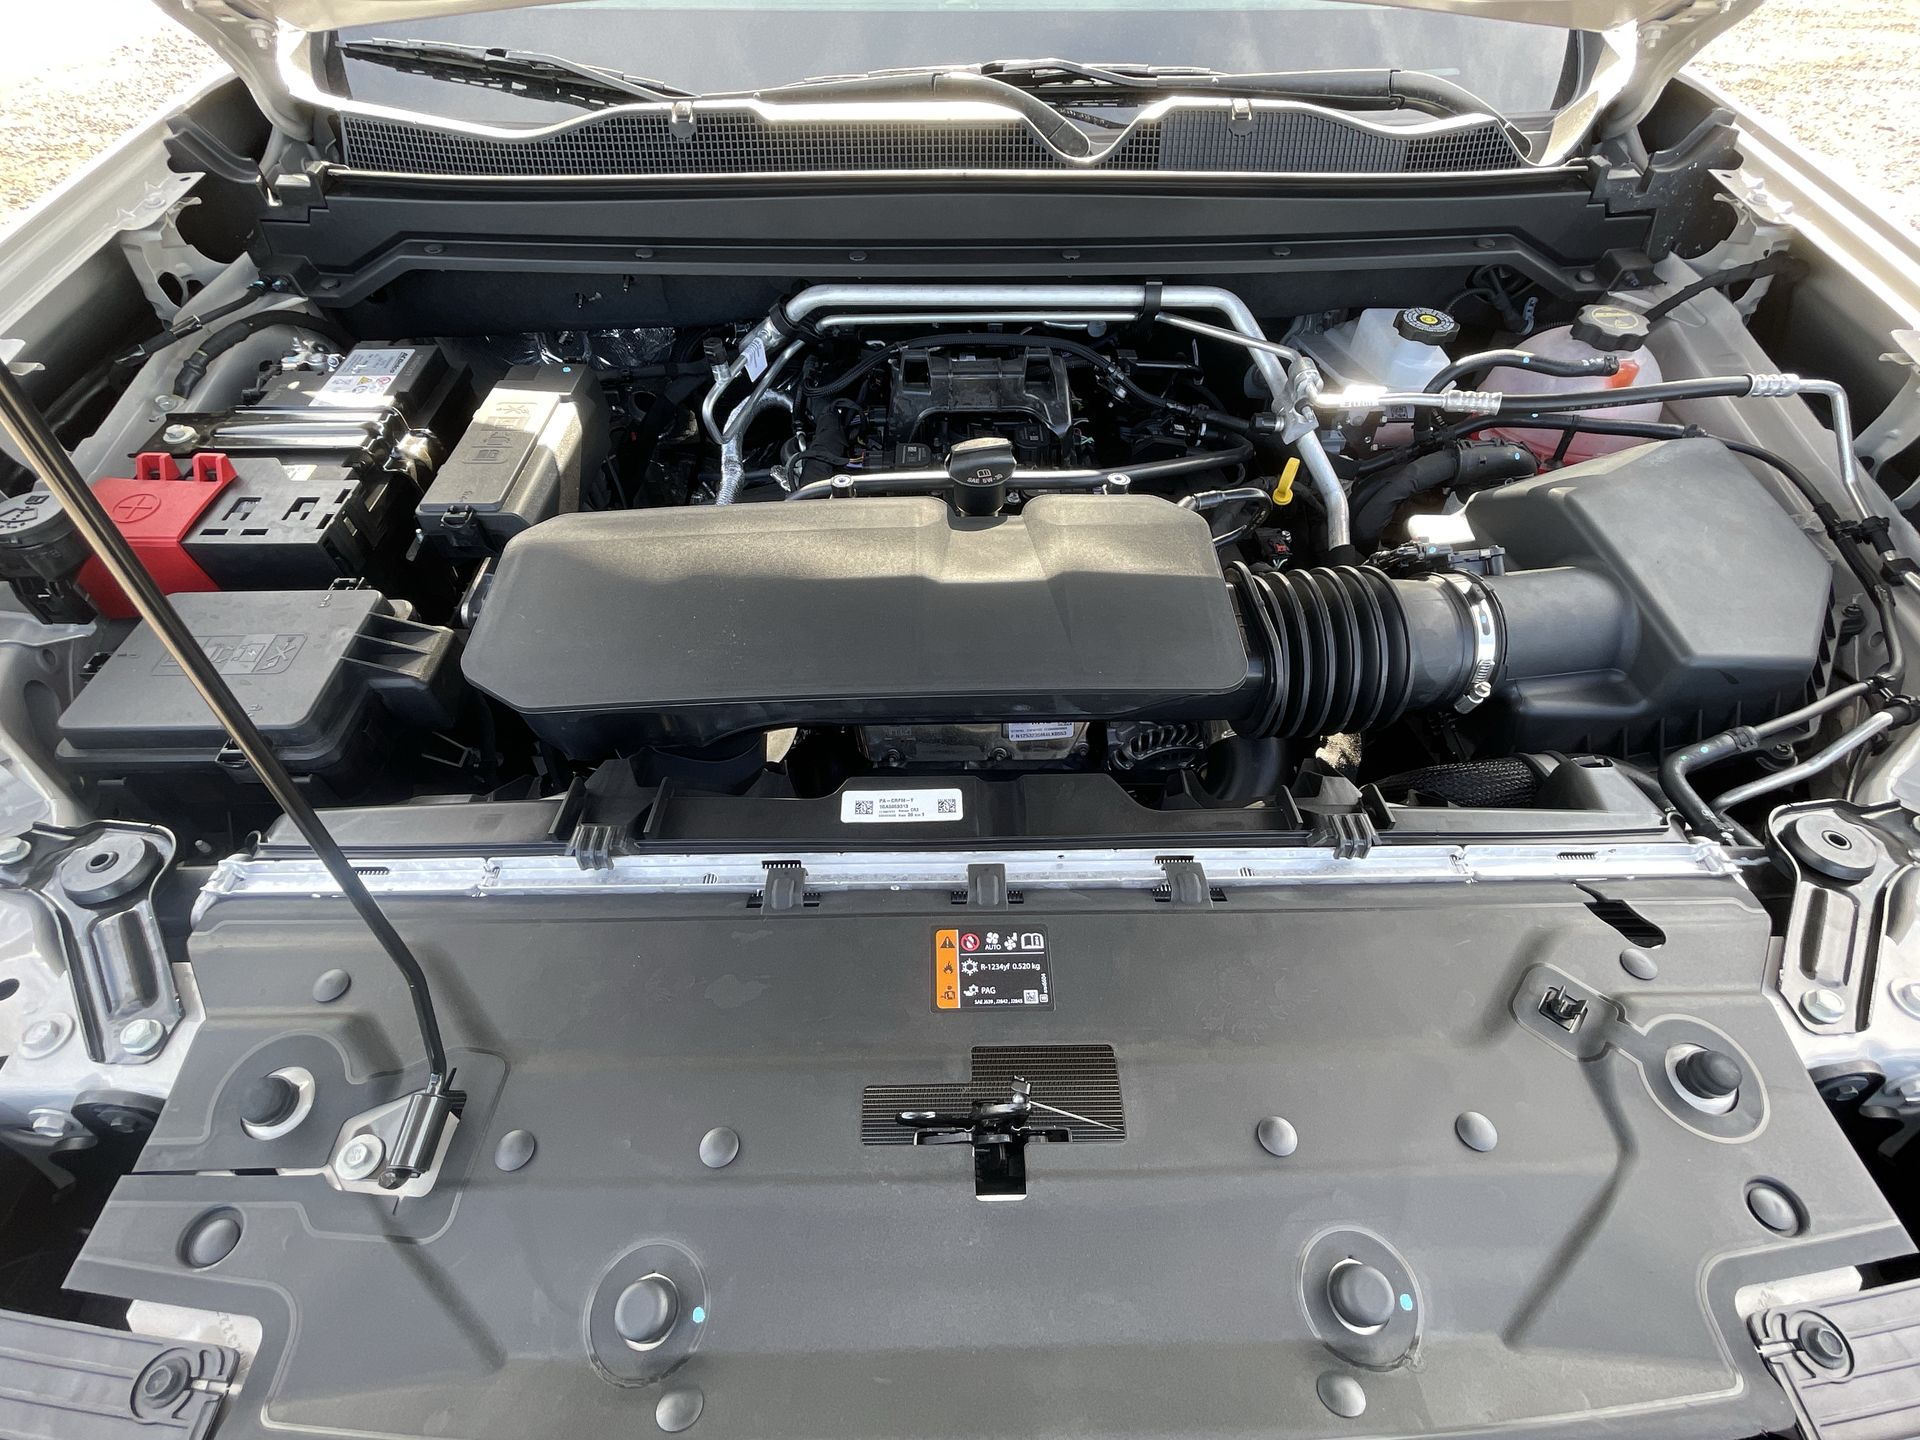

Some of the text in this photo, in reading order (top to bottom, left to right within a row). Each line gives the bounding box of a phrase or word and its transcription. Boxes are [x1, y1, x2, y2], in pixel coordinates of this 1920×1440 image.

[980, 962, 1041, 972] R-1234yf 0.520 kg
[981, 986, 996, 995] PAG
